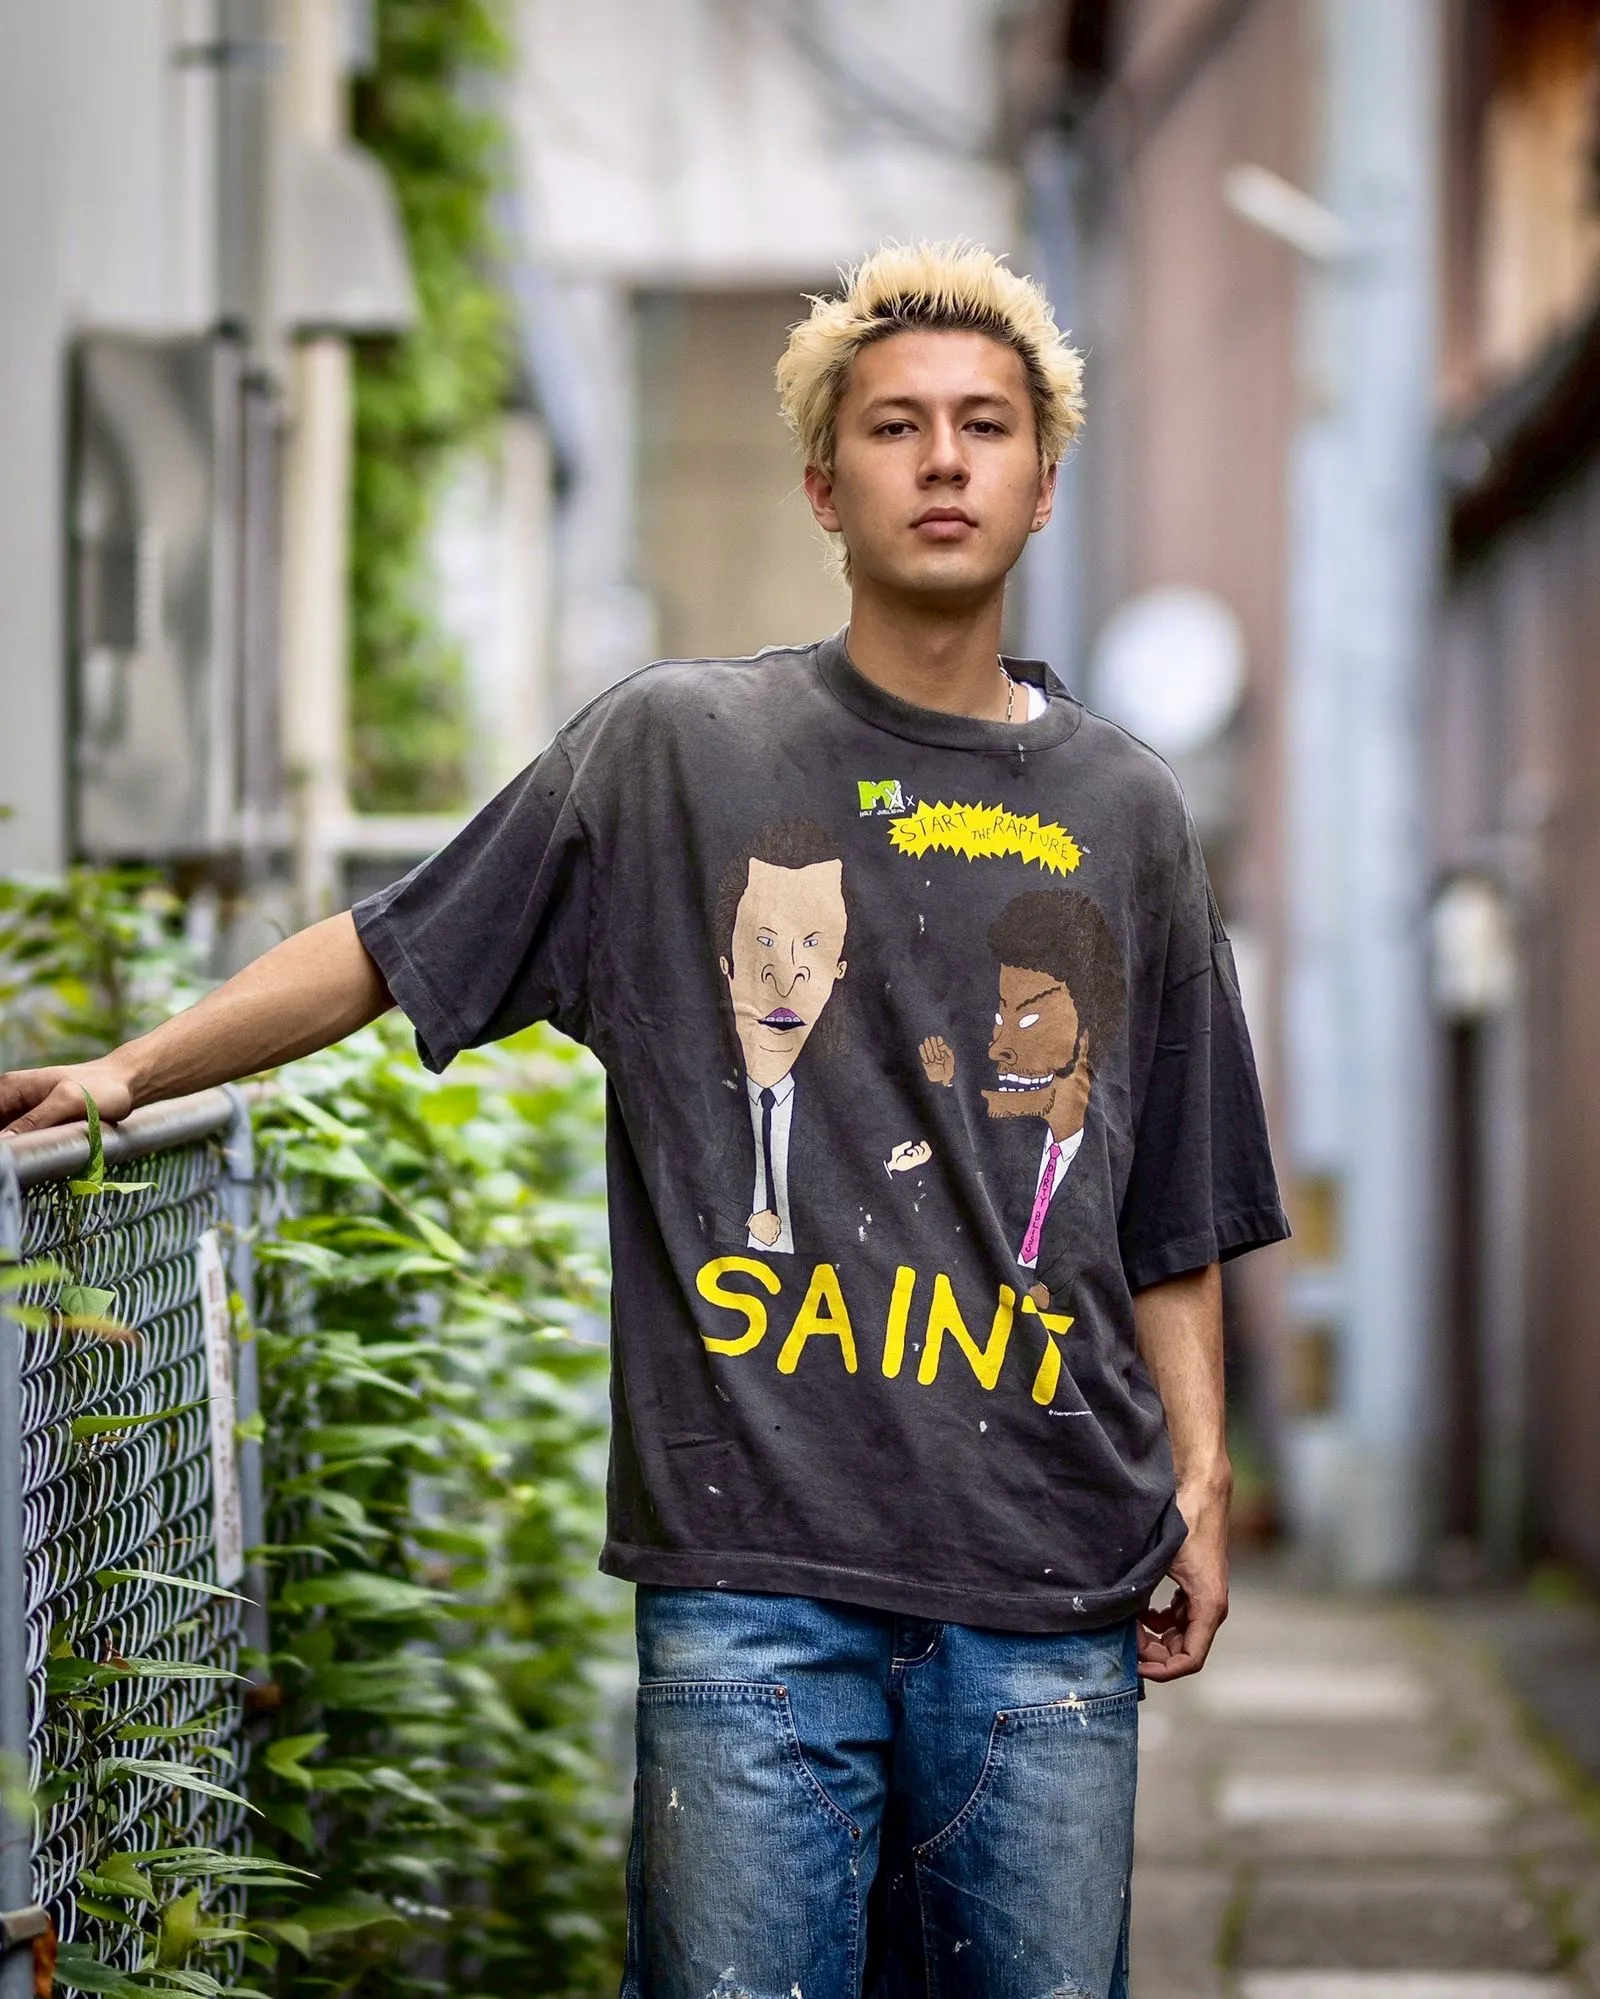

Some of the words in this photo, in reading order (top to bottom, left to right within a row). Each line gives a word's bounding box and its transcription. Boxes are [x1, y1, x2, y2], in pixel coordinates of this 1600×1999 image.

[899, 810, 967, 843] START
[971, 828, 991, 841] THE
[993, 814, 1071, 861] RAPTURE
[1038, 1163, 1054, 1208] DIRTY
[1024, 1212, 1042, 1253] BLISS
[694, 1255, 1076, 1406] SAINT
